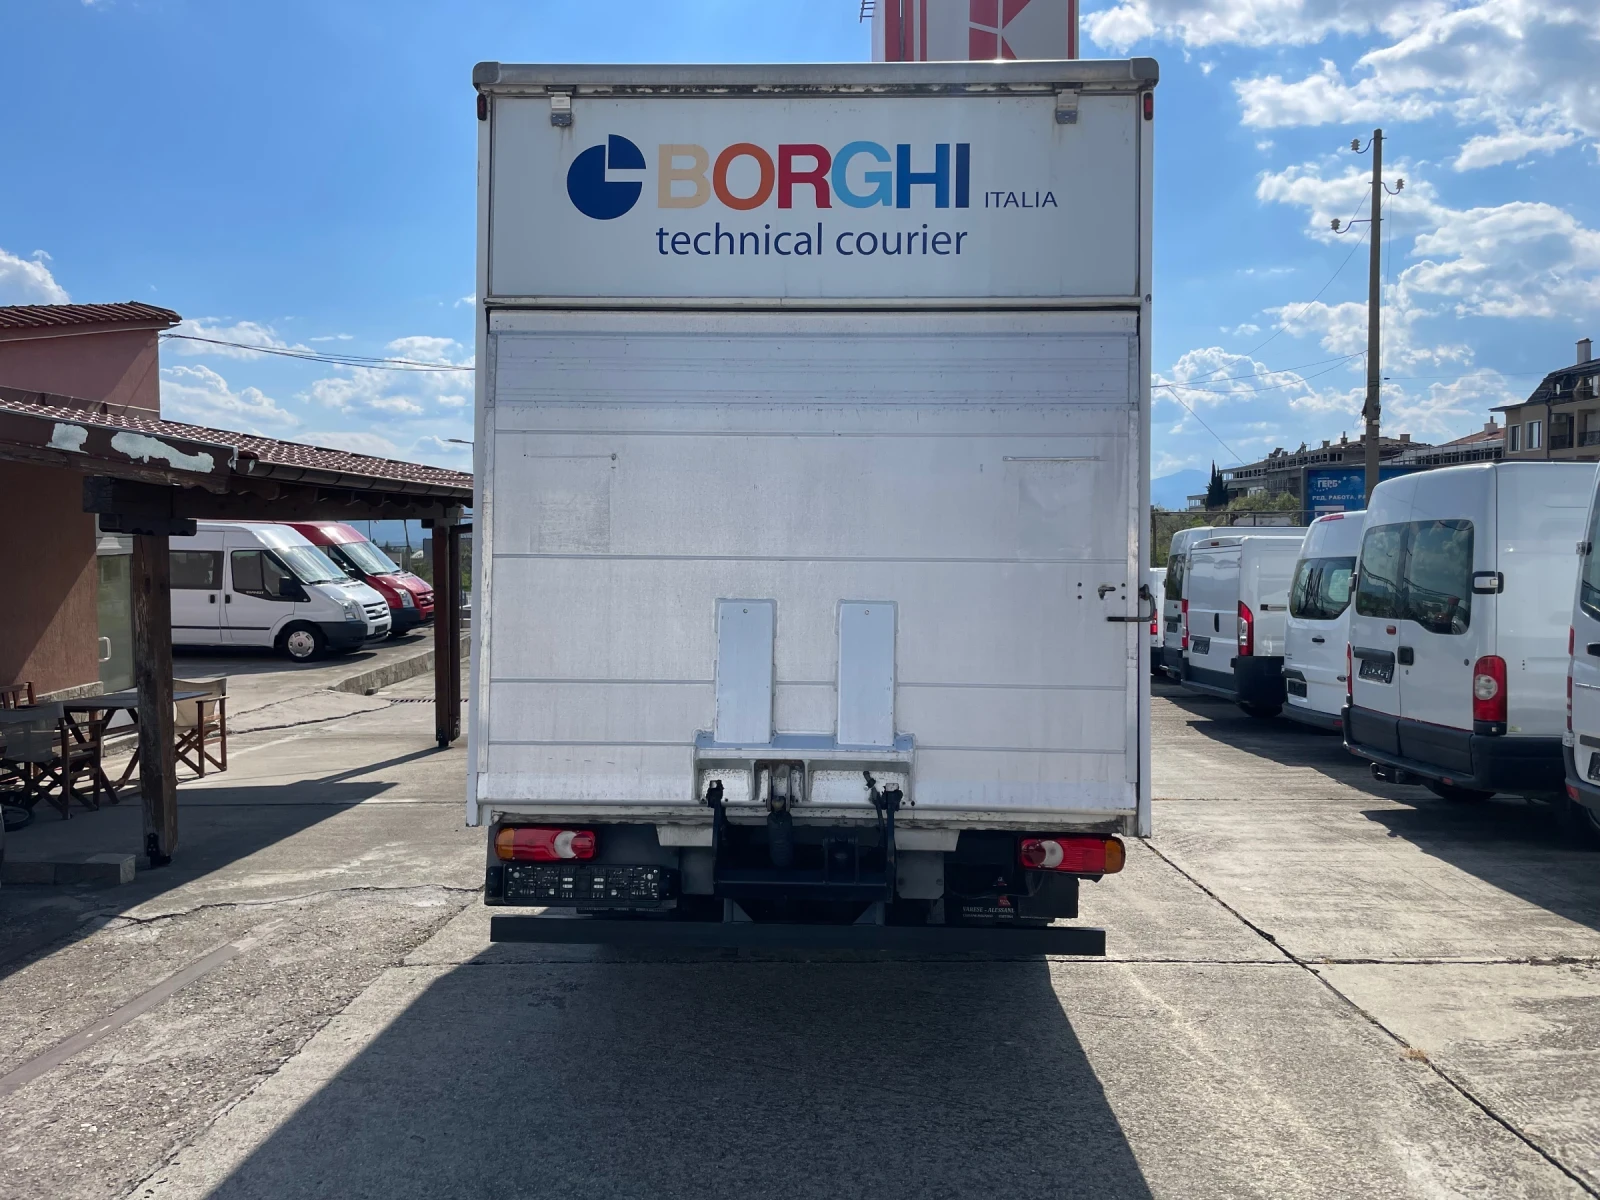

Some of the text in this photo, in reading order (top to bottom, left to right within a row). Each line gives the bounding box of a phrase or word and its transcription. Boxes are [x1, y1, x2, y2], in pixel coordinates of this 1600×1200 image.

[657, 140, 1059, 211] BORGHI ITALIA
[656, 222, 968, 256] technical courier
[1317, 480, 1338, 488] ГЕРБ
